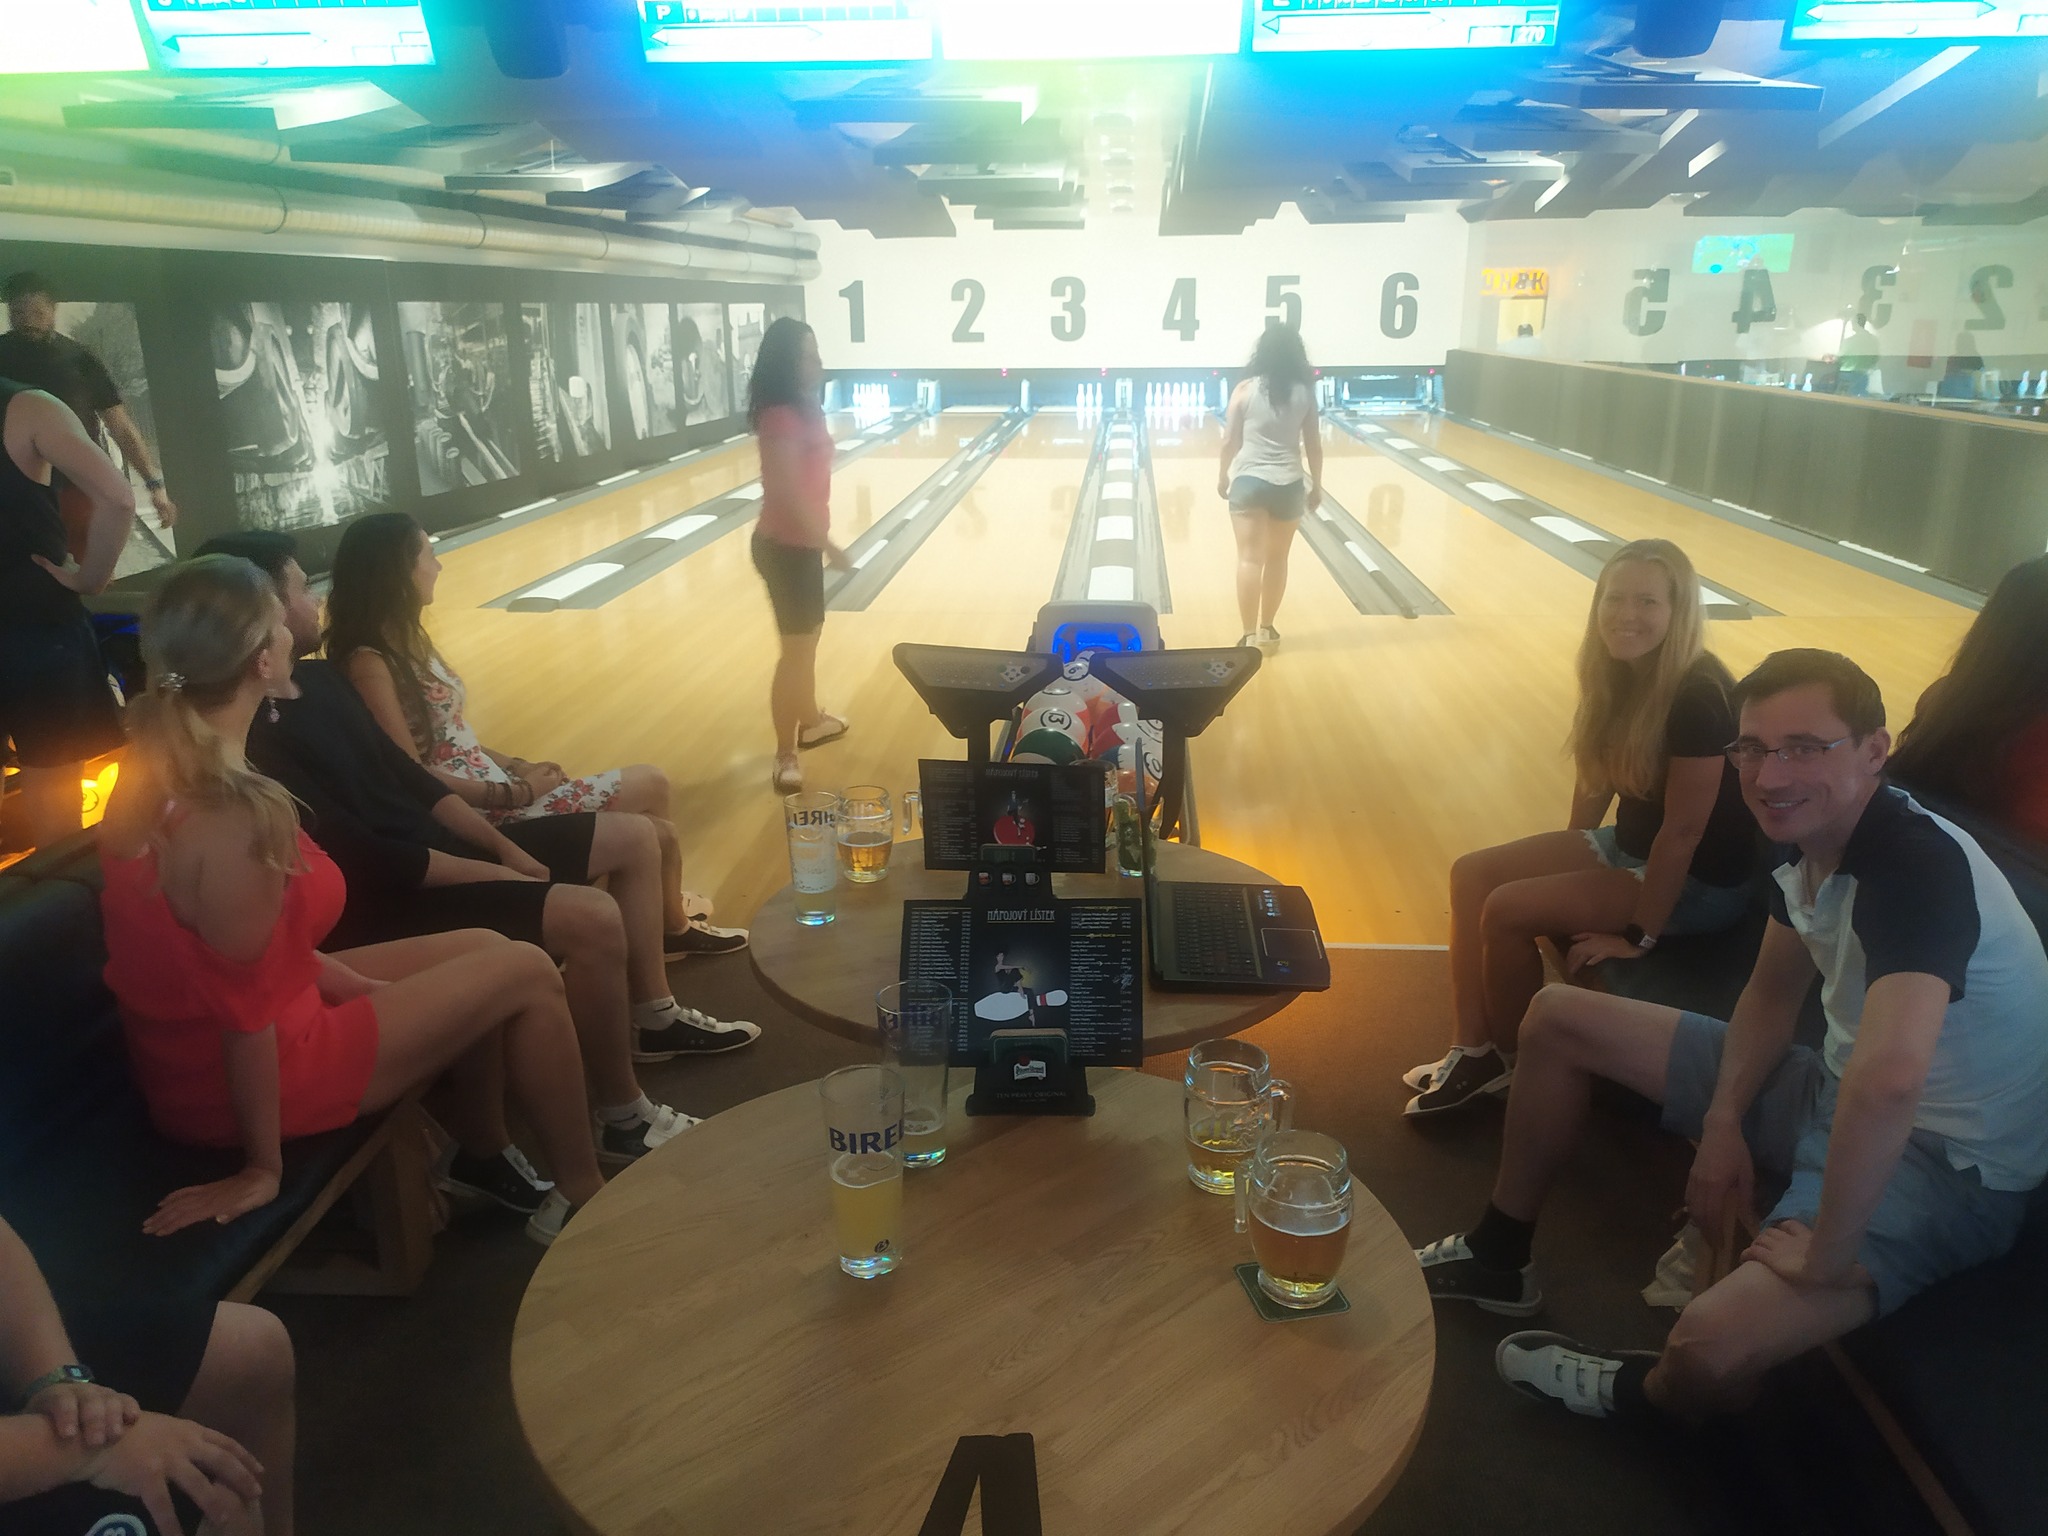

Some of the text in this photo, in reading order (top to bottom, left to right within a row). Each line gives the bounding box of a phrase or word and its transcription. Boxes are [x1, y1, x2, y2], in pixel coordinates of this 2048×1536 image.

[838, 280, 866, 344] 1
[951, 278, 986, 343] 2
[1050, 276, 1086, 342] 3
[1162, 277, 1200, 342] 4
[1264, 275, 1303, 334] 5
[1379, 272, 1420, 340] 6
[987, 908, 1028, 921] NÁPOJOVÝ
[1030, 908, 1056, 921] LÍSTEK
